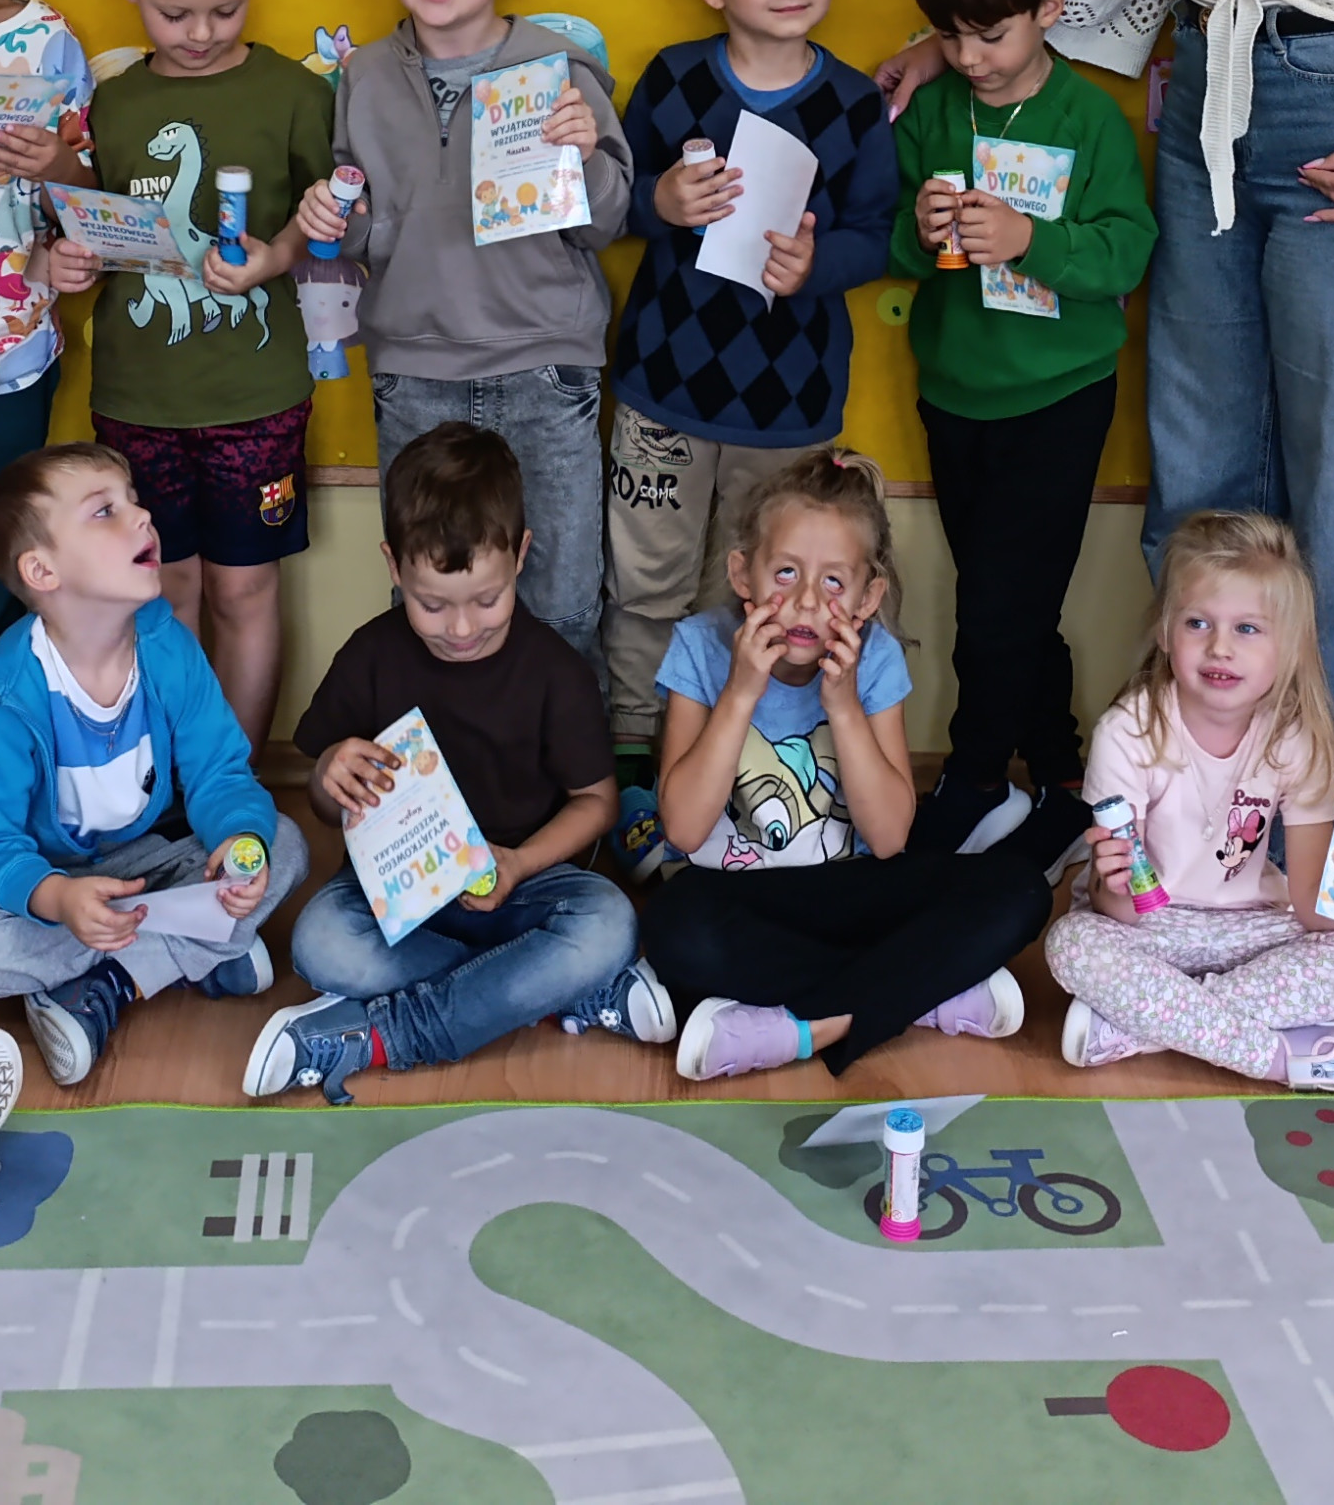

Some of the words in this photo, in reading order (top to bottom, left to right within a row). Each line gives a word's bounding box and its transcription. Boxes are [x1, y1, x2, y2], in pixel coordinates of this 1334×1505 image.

[489, 89, 559, 125] DYPLOM
[490, 113, 551, 138] WYJĄTKOWE
[494, 130, 544, 148] PRZEDSZKOL
[130, 175, 172, 197] DINO
[986, 171, 1053, 200] DYPLOM
[996, 196, 1048, 213] ĄTKOWEGO
[72, 205, 155, 231] DYPLOM
[78, 220, 157, 241] WYJĄTKOWEGO
[86, 230, 159, 246] PRZEDSZKOLAKA
[610, 460, 682, 511] ROAR
[640, 485, 679, 500] SOME
[1231, 789, 1271, 808] Love
[372, 810, 440, 864] PRZEDSZKOLAKA
[377, 819, 450, 877] WYJĄTKOWEGO
[383, 830, 463, 900] DYPLOM
